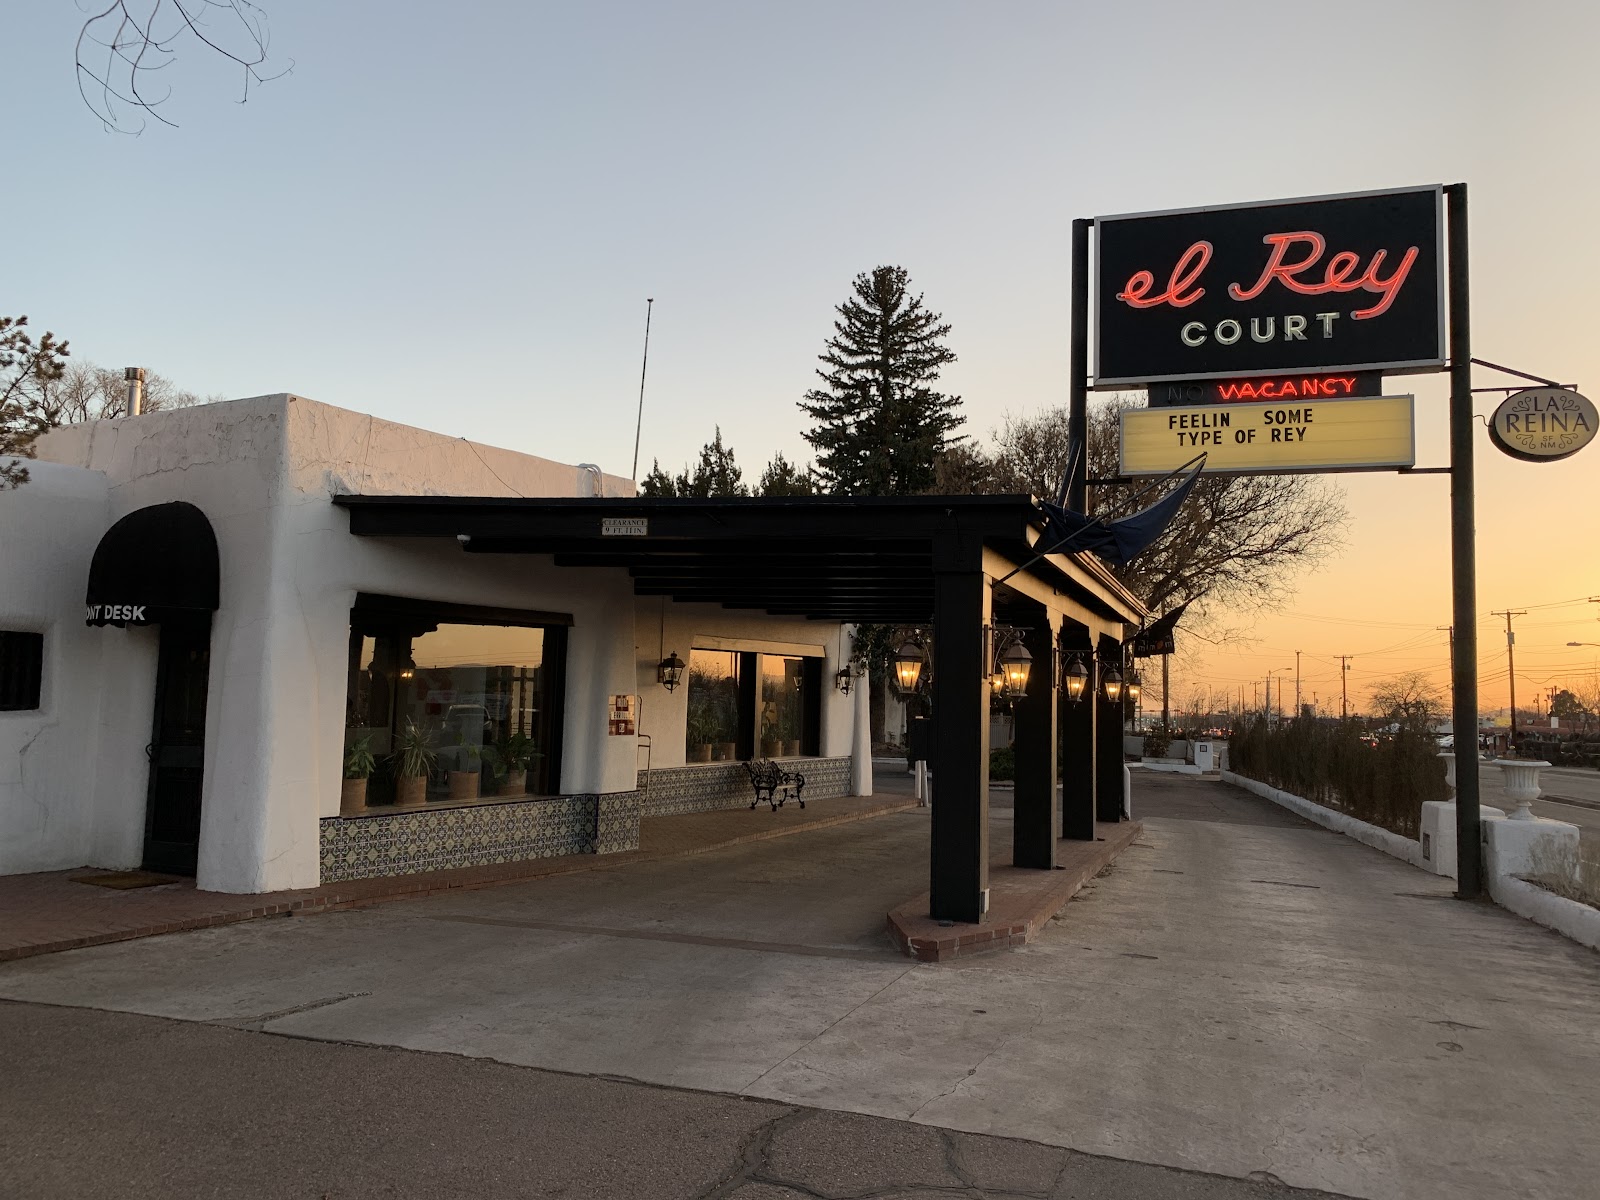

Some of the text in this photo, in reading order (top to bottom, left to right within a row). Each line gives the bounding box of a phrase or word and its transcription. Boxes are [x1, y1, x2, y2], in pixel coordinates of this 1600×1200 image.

[1116, 231, 1420, 320] el Rey
[1180, 312, 1340, 347] COURT
[1167, 377, 1357, 401] NO VACANCY
[1534, 396, 1560, 411] LA
[1168, 409, 1313, 430] FEELIN SOME
[1506, 413, 1590, 433] REINA
[1177, 427, 1308, 447] TYPE OF REY
[104, 604, 146, 620] DESK
